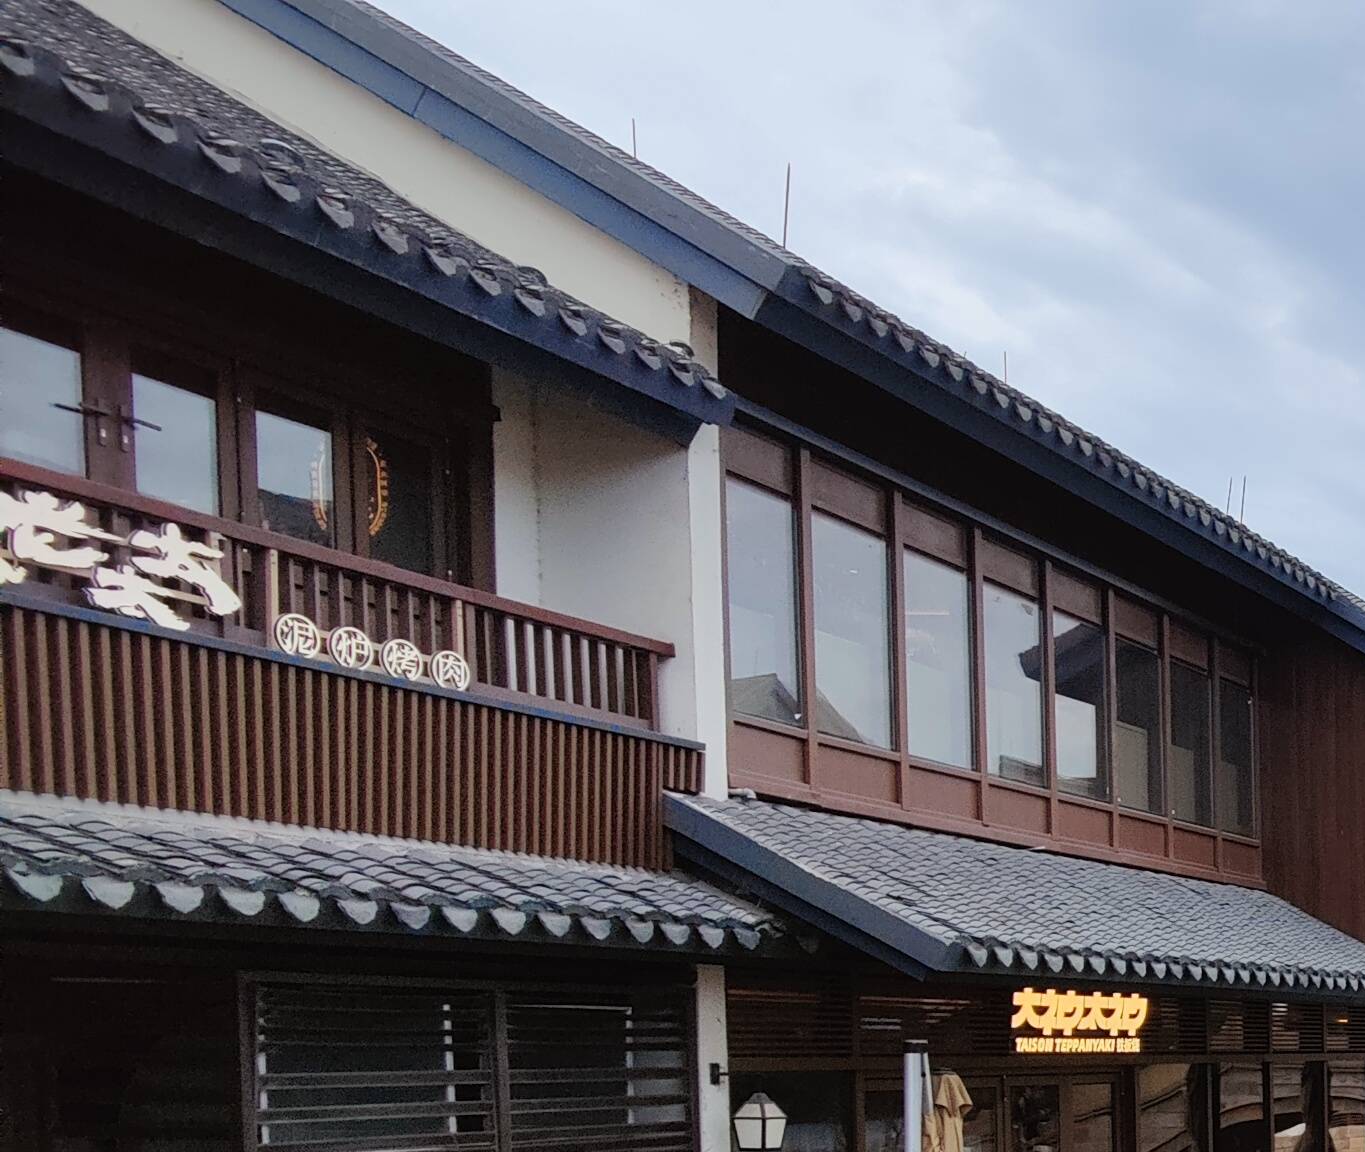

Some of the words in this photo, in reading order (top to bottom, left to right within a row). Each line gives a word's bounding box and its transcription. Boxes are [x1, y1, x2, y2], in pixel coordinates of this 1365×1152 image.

[275, 614, 471, 691] 泥炉烤肉
[1015, 1037, 1054, 1053] TAISON
[1055, 1038, 1116, 1053] TEPPANYAKI
